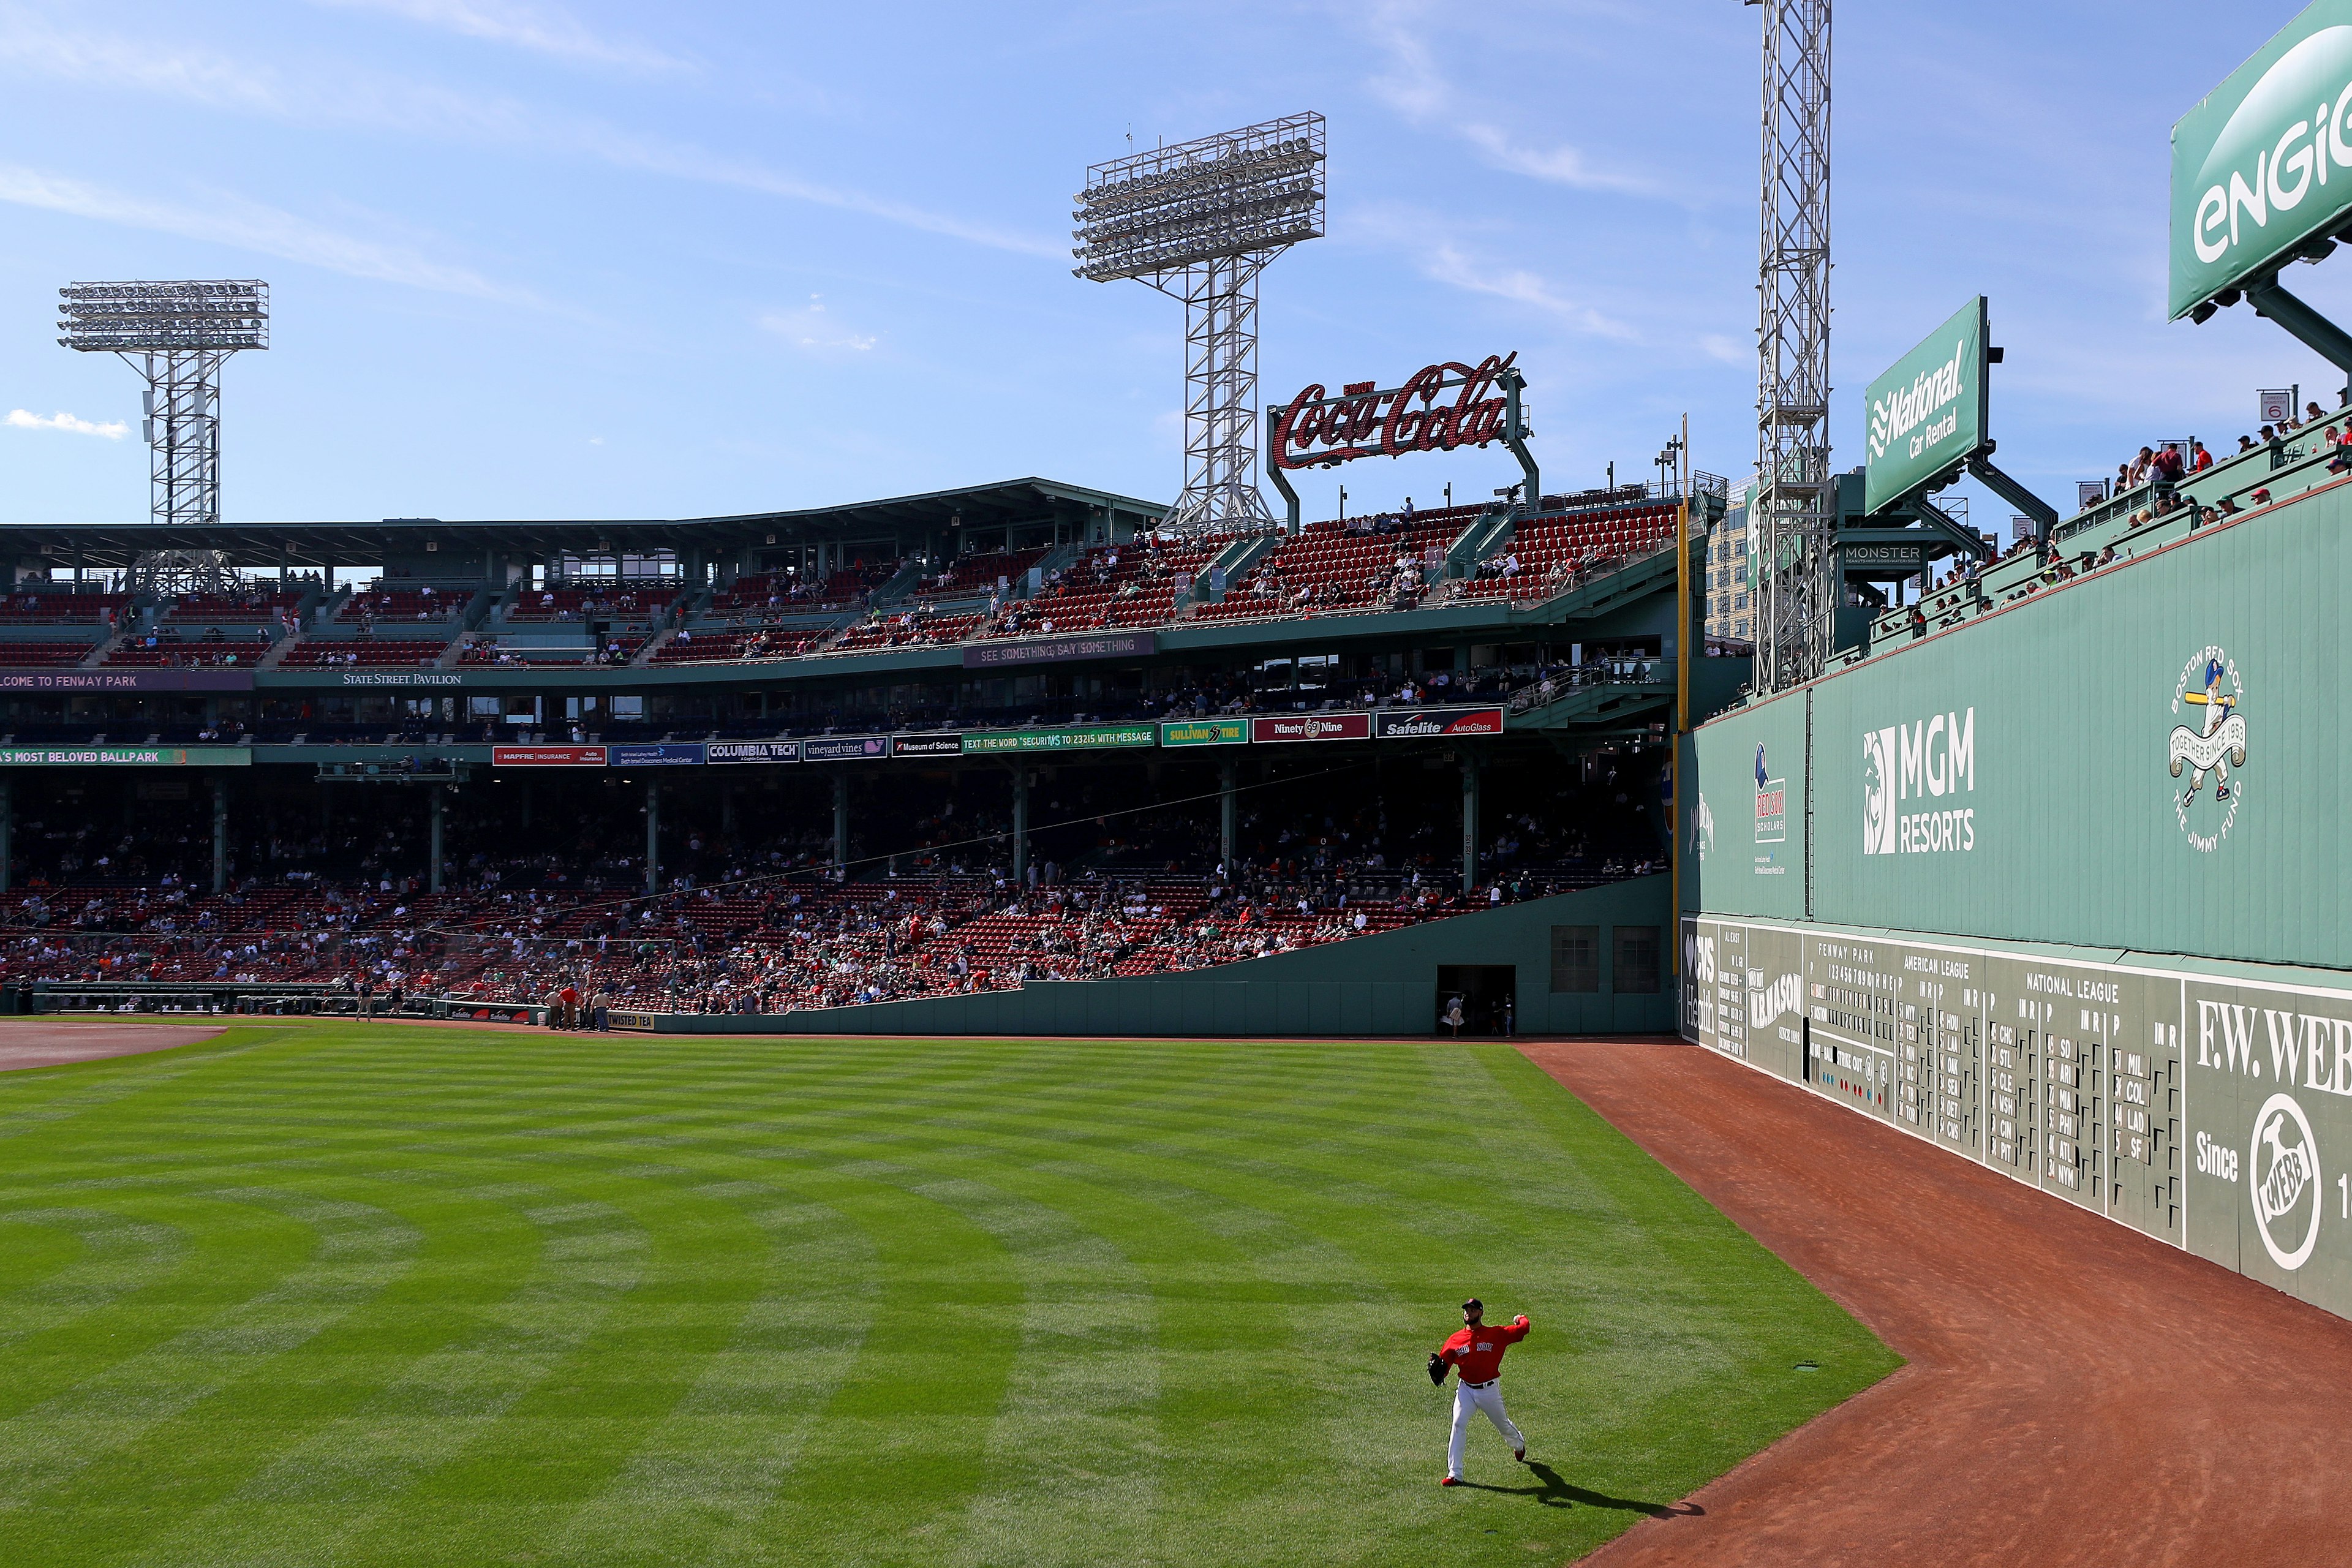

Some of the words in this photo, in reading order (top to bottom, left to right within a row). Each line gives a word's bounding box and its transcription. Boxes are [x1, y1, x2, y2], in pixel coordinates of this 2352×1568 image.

[1343, 381, 1376, 396] ENJOY
[1886, 339, 1963, 447] National
[1272, 350, 1517, 470] Coca-Cola
[2269, 405, 2282, 418] 6
[1909, 439, 1924, 460] Car
[1925, 407, 1956, 450] Rental
[2019, 527, 2027, 536] 3
[1845, 548, 1920, 558] MONSTER
[981, 650, 998, 662] SEE
[38, 676, 52, 687] TO
[56, 676, 102, 687] FENWAY
[106, 676, 137, 687] PARK
[2171, 649, 2203, 715] BOSTON
[2204, 645, 2225, 665] RED
[2226, 658, 2244, 701] SOX
[1221, 727, 1240, 738] TIRE
[1274, 724, 1304, 735] Ninety
[1321, 722, 1343, 733] Nine
[1387, 722, 1441, 735] Safelite
[1452, 723, 1491, 733] AutoGlass
[807, 742, 840, 756] vineyard
[841, 743, 862, 753] vines
[963, 739, 982, 748] TEXT
[983, 739, 997, 747] THE
[998, 738, 1017, 747] WORD
[1061, 735, 1071, 744] TO
[1072, 734, 1095, 744] 23215
[1097, 733, 1115, 742] WITH
[1117, 731, 1152, 742] MESSAGE
[2171, 738, 2204, 761] TOGETHER
[2205, 732, 2226, 761] SINCE
[2227, 722, 2244, 742] 1953
[15, 752, 45, 763] MOST
[48, 752, 97, 763] BELOVED
[100, 752, 159, 763] BALLPARK
[709, 745, 769, 757] COLUMBIA
[770, 744, 796, 756] TECH
[1901, 706, 1974, 800] MGM
[1757, 792, 1770, 818] RED
[1770, 789, 1784, 816] SOX
[1698, 792, 1714, 853] BEAM
[1757, 820, 1784, 832] SCHOLARS
[2173, 788, 2187, 832] THE
[2187, 830, 2218, 853] JIMMY
[2220, 780, 2242, 840] FUND
[1901, 808, 1974, 854] RESORTS
[1724, 931, 1730, 943] AL
[1730, 932, 1740, 944] EAST
[1694, 935, 1714, 984] CVS
[1818, 942, 1848, 960] FENWAY
[1852, 948, 1874, 964] PARK
[1904, 955, 1938, 974] AMERICAN
[1941, 960, 1969, 979] LEAGUE
[1898, 976, 1902, 992] P
[1920, 980, 1926, 998] IN
[1928, 981, 1932, 999] R
[2026, 972, 2073, 997] NATIONAL
[2077, 981, 2119, 1004] LEAGUE
[1686, 984, 1715, 1035] Health
[1905, 1004, 1915, 1022] NYY
[608, 1014, 636, 1026] TWISTED
[638, 1016, 652, 1027] TEA
[1947, 1012, 1959, 1031] HOU
[2113, 1014, 2120, 1036] P
[2154, 1022, 2165, 1046] IN
[2168, 1024, 2177, 1048] R
[1905, 1023, 1915, 1041] TEX
[1999, 1025, 2013, 1046] CHC
[1905, 1044, 1915, 1062] MIN
[1947, 1034, 1958, 1054] LAA
[2060, 1038, 2071, 1059] SD
[1837, 1049, 1852, 1069] STRIKE
[1852, 1055, 1863, 1074] OUT
[1947, 1056, 1958, 1076] OAK
[1999, 1048, 2012, 1069] STL
[2128, 1053, 2144, 1078] MIL
[1907, 1065, 1914, 1082] KC
[1999, 1072, 2013, 1093] CLE
[2059, 1063, 2071, 1085] ARI
[1907, 1085, 1914, 1103] TB
[1947, 1078, 1958, 1097] SEA
[2126, 1080, 2145, 1106] COL
[1947, 1099, 1958, 1120] DET
[1999, 1094, 2013, 1117] WSH
[2059, 1088, 2071, 1112] MIA
[1905, 1104, 1916, 1123] TOR
[2127, 1107, 2144, 1134] LAD
[1947, 1120, 1959, 1141] CWS
[2000, 1118, 2012, 1140] CIN
[2059, 1114, 2072, 1137] PHI
[2000, 1141, 2011, 1163] PIT
[2059, 1139, 2073, 1164] ATL
[2130, 1136, 2143, 1160] SF
[2058, 1164, 2074, 1189] NYM
[2196, 1130, 2239, 1183] Since
[2267, 1152, 2303, 1213] WEBB
[1455, 1344, 1470, 1357] RED
[1476, 1342, 1494, 1352] SOX
